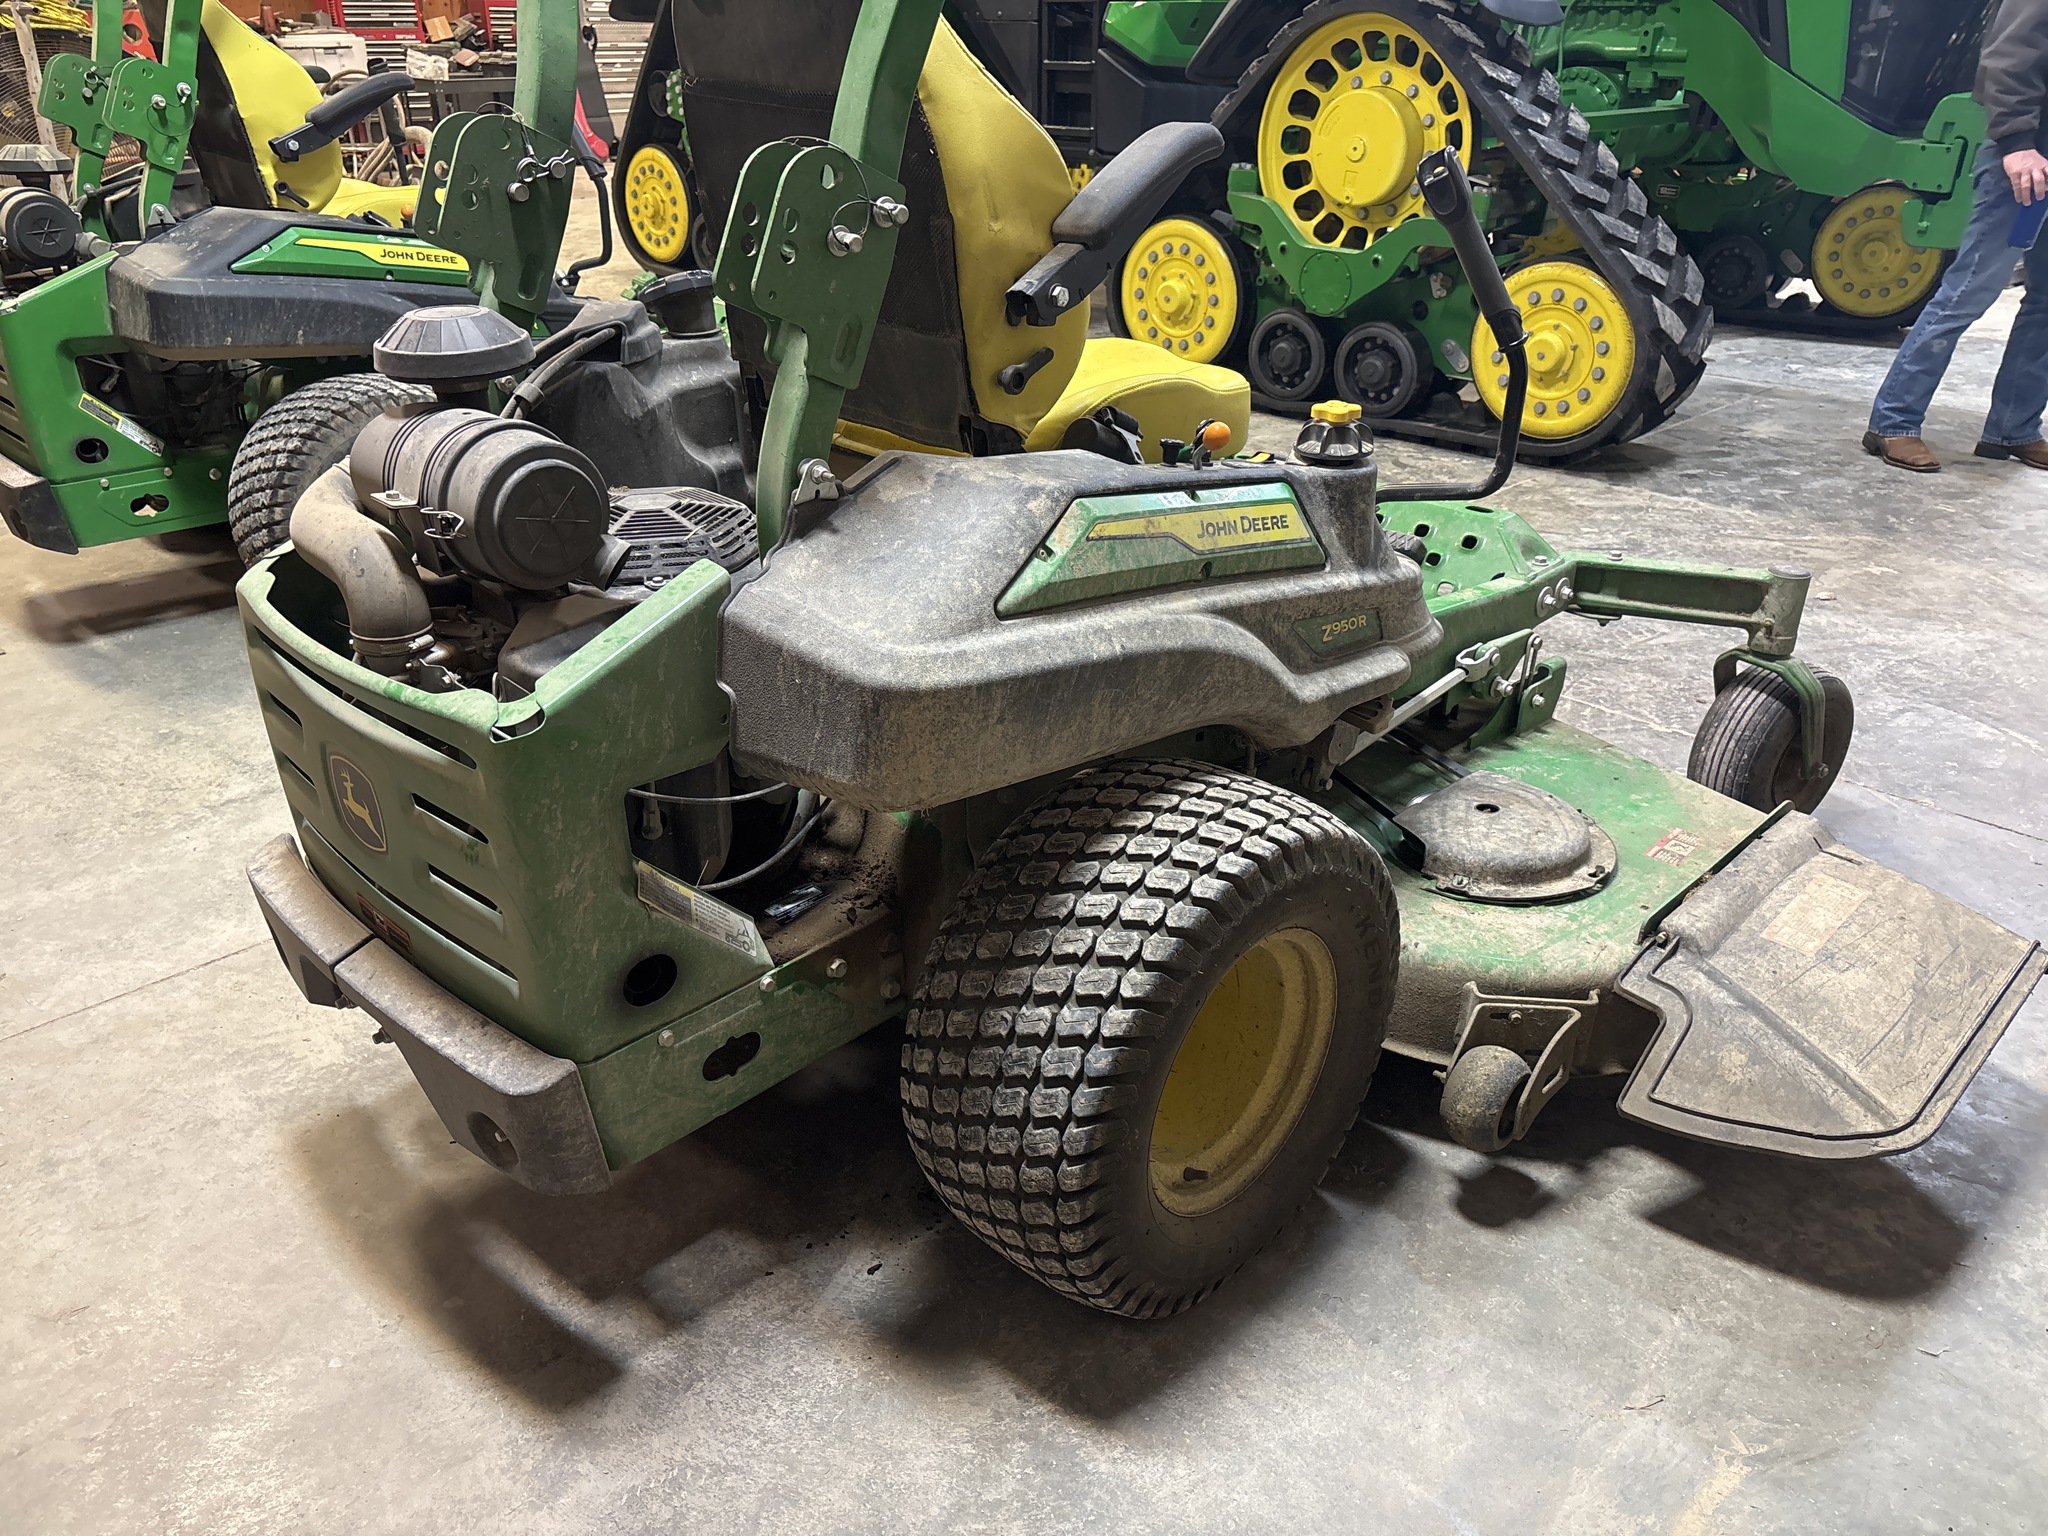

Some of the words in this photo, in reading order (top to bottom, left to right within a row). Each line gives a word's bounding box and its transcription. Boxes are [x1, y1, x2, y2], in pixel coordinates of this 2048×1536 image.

[380, 248, 414, 261] JOHN
[416, 251, 458, 264] DEERE
[1197, 519, 1239, 539] JOHN
[1240, 514, 1290, 534] DEERE
[1321, 614, 1367, 643] Z950R
